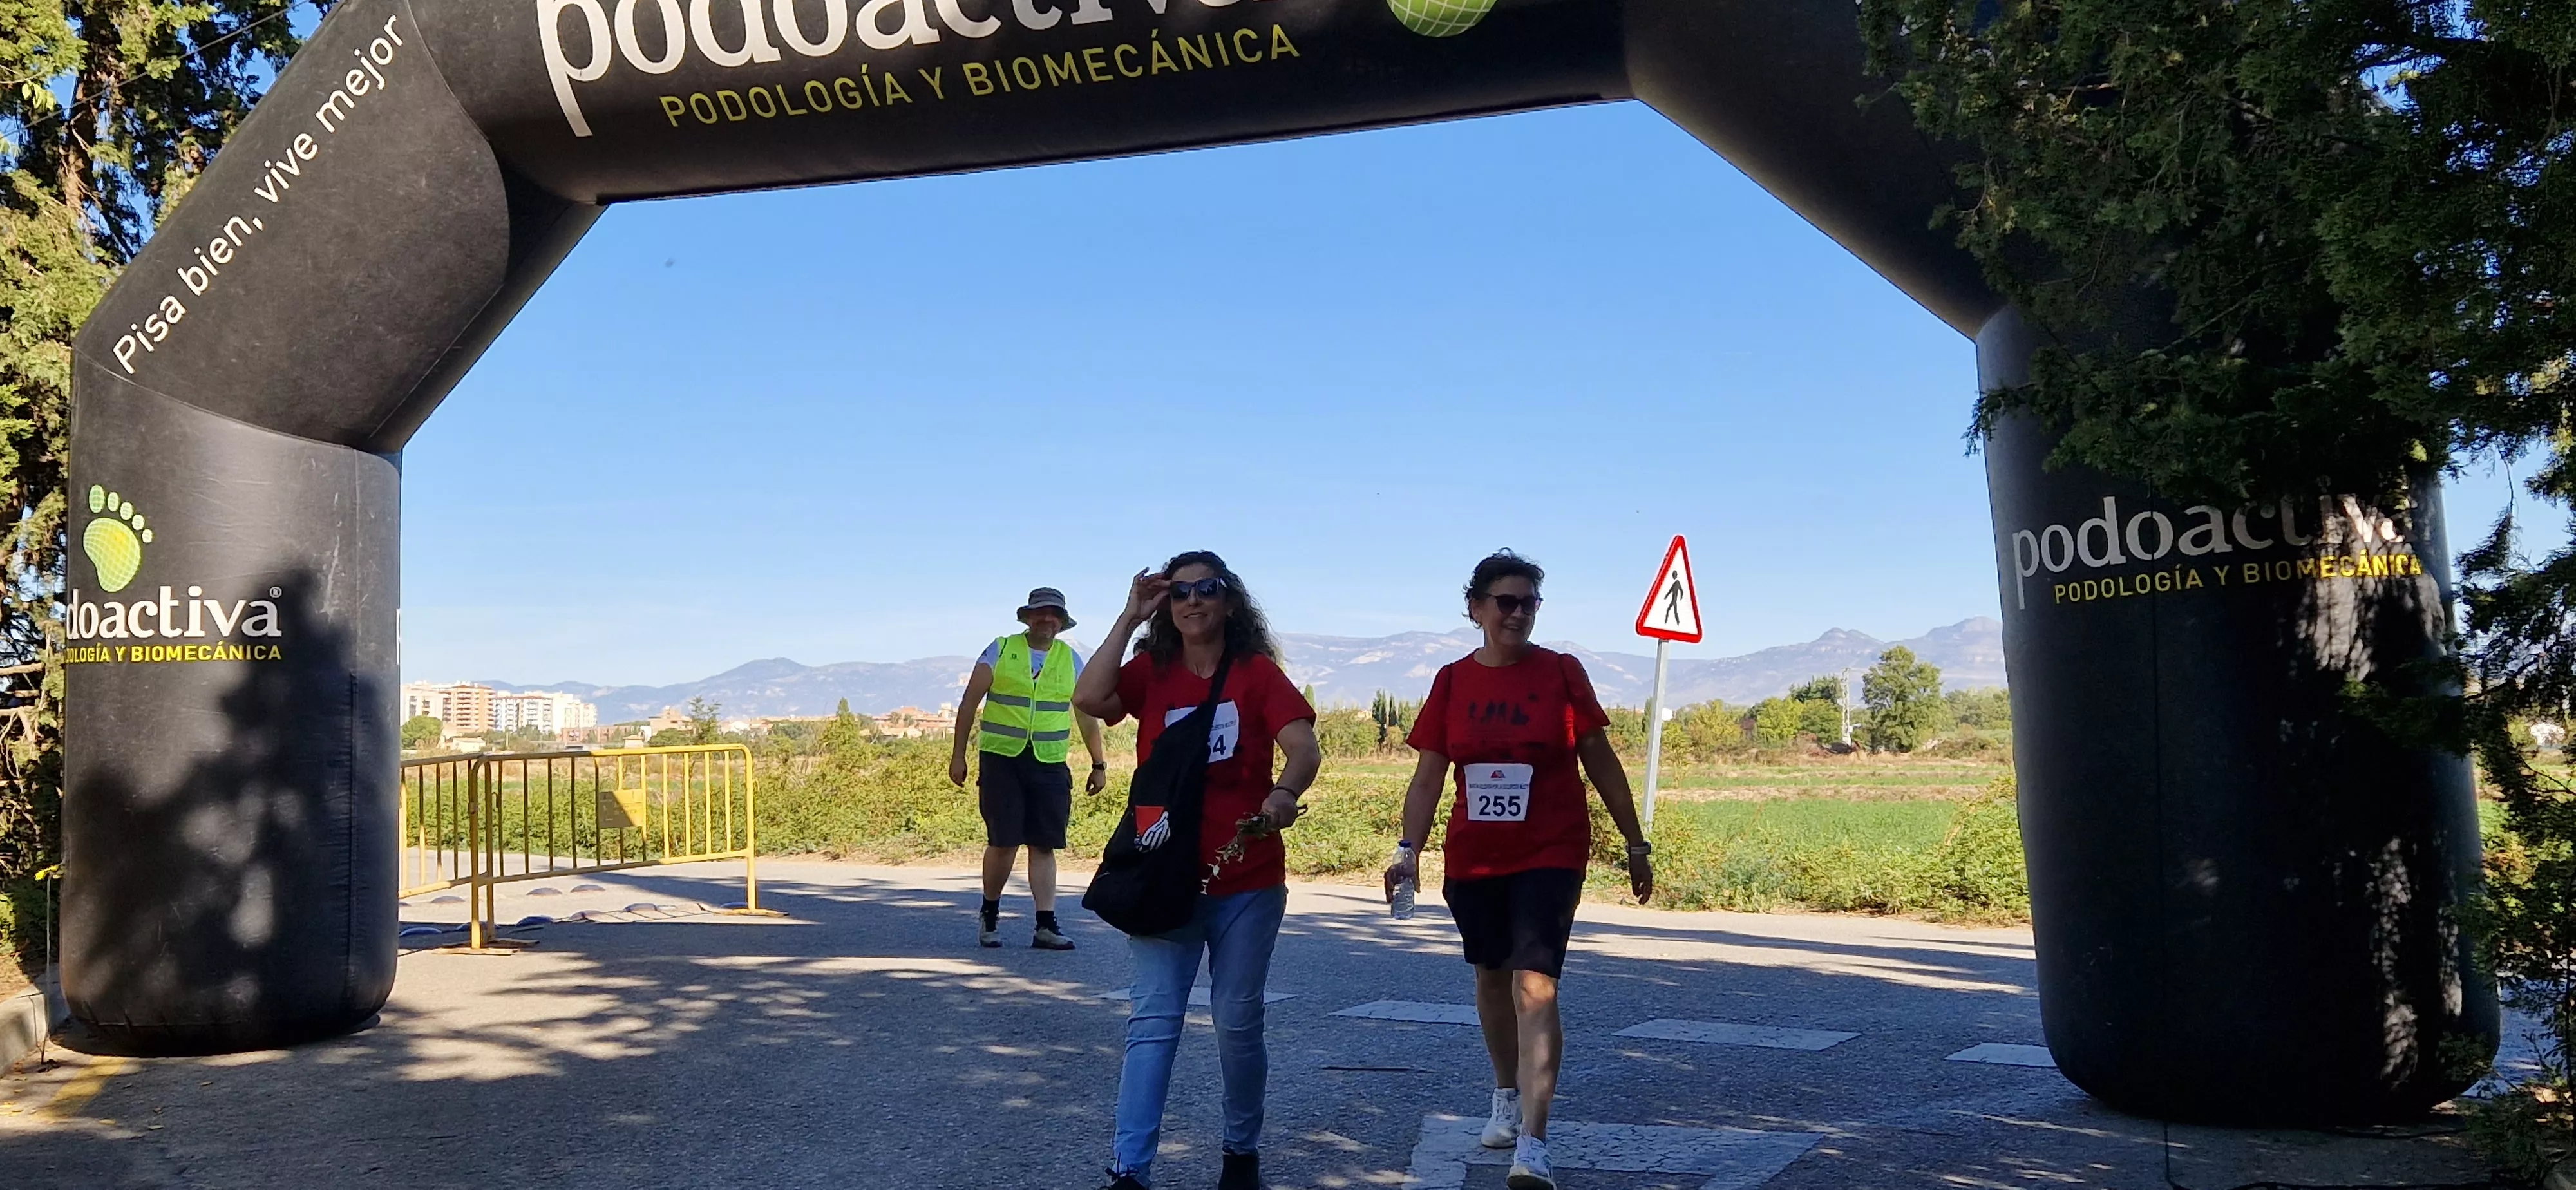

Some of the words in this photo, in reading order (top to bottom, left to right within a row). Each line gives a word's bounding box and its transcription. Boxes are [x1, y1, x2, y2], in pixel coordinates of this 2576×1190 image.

[659, 63, 913, 127] PODOLOGÍA
[918, 66, 945, 100] Y
[962, 24, 1301, 96] BIOMECÁNICA
[113, 294, 186, 374] Pisa
[178, 214, 264, 297] bien,
[254, 133, 319, 203] vive
[315, 14, 404, 133] mejor
[2054, 565, 2203, 604] PODOLOGÍA
[2213, 565, 2230, 587] Y
[2242, 548, 2423, 583] BIOMECÁNICA
[115, 645, 126, 663] Y
[131, 641, 282, 662] BIOMECÁNICA
[1209, 734, 1227, 755] 4
[1479, 795, 1521, 817] 255
